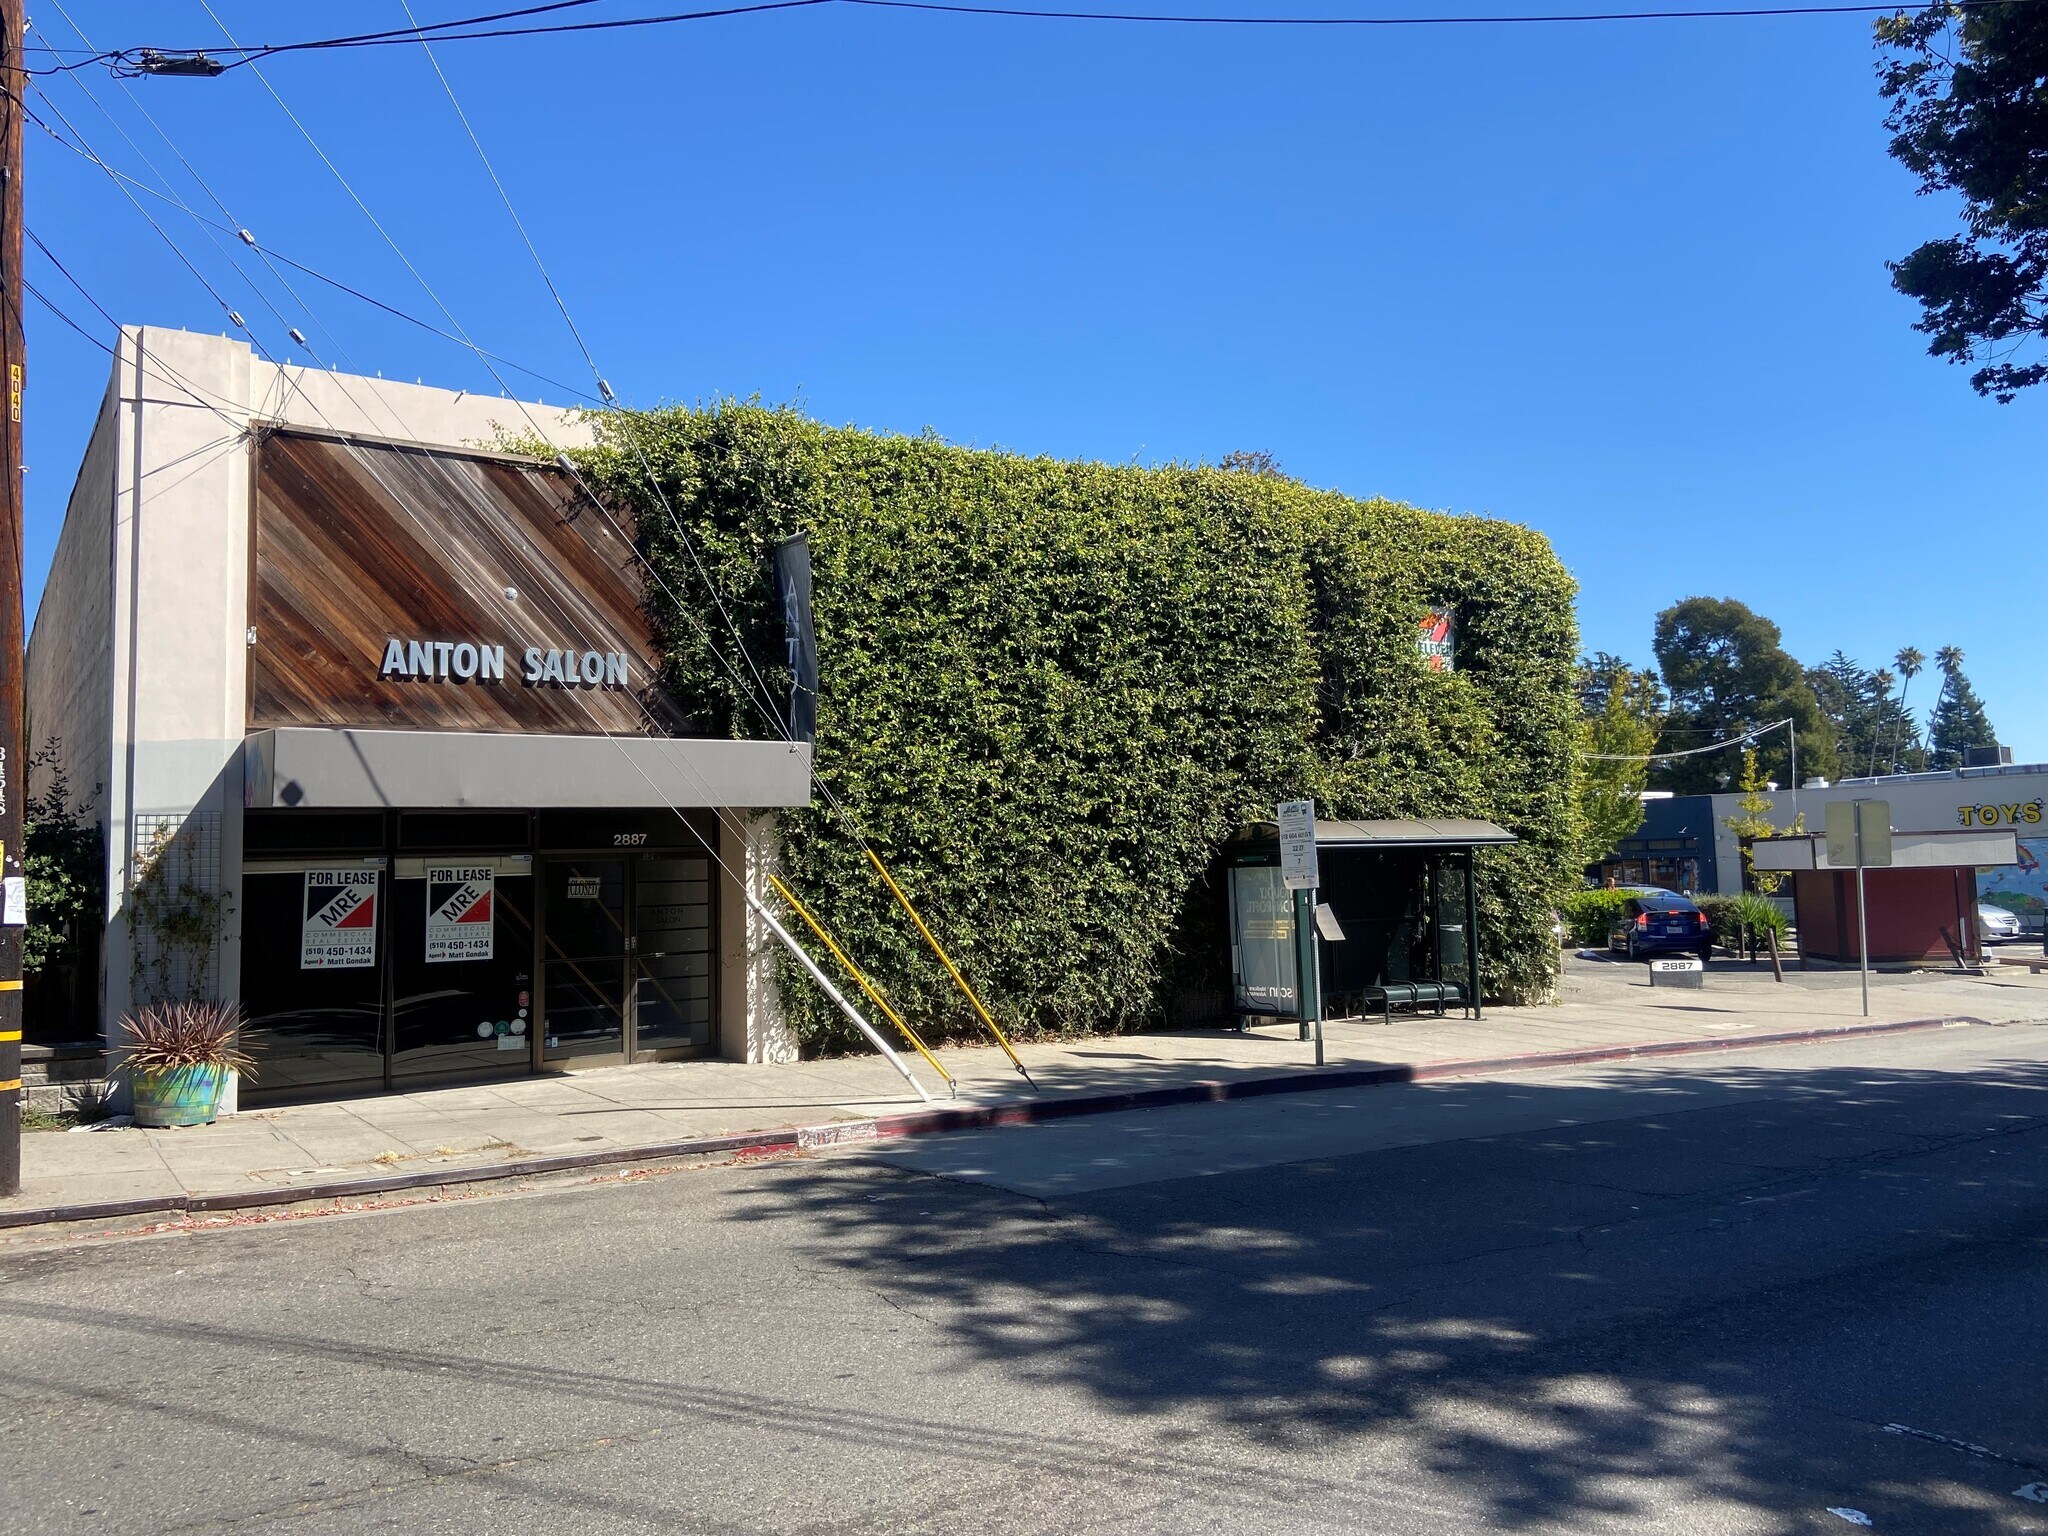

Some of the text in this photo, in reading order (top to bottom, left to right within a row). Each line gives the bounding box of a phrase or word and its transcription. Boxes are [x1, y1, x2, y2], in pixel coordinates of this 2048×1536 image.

[381, 638, 628, 686] ANTON SALON
[1957, 802, 2042, 827] TOYS
[613, 833, 648, 846] 2887
[308, 872, 375, 885] FOR LEASE
[430, 869, 492, 882] FOR LEASE
[319, 888, 362, 927] MRE
[440, 885, 480, 922] MRE
[650, 908, 683, 916] ANTON
[306, 946, 372, 956] (510) 450-1434
[430, 940, 489, 950] (510) 450-1434
